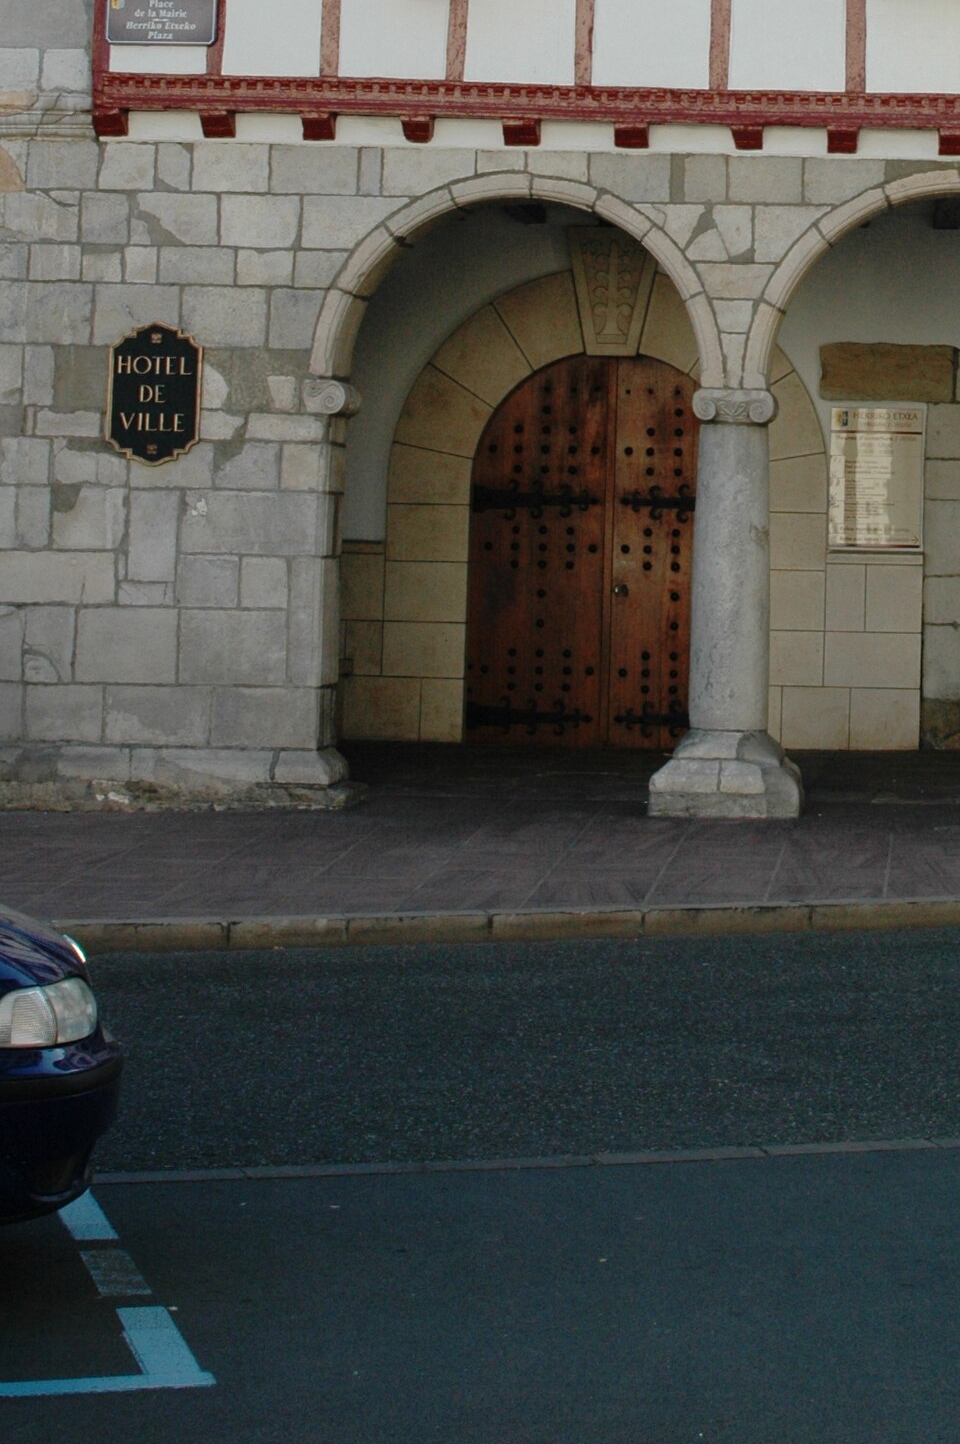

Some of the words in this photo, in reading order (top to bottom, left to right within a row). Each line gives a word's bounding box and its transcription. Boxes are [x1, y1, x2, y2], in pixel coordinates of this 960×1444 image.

[149, 0, 174, 8] Place
[134, 9, 146, 18] de
[147, 9, 157, 18] la
[159, 9, 188, 18] Mairie
[126, 21, 163, 30] Herriko
[147, 31, 173, 39] Plaza
[117, 355, 192, 375] HOTEL
[139, 384, 166, 404] DE
[120, 412, 185, 432] VILLE
